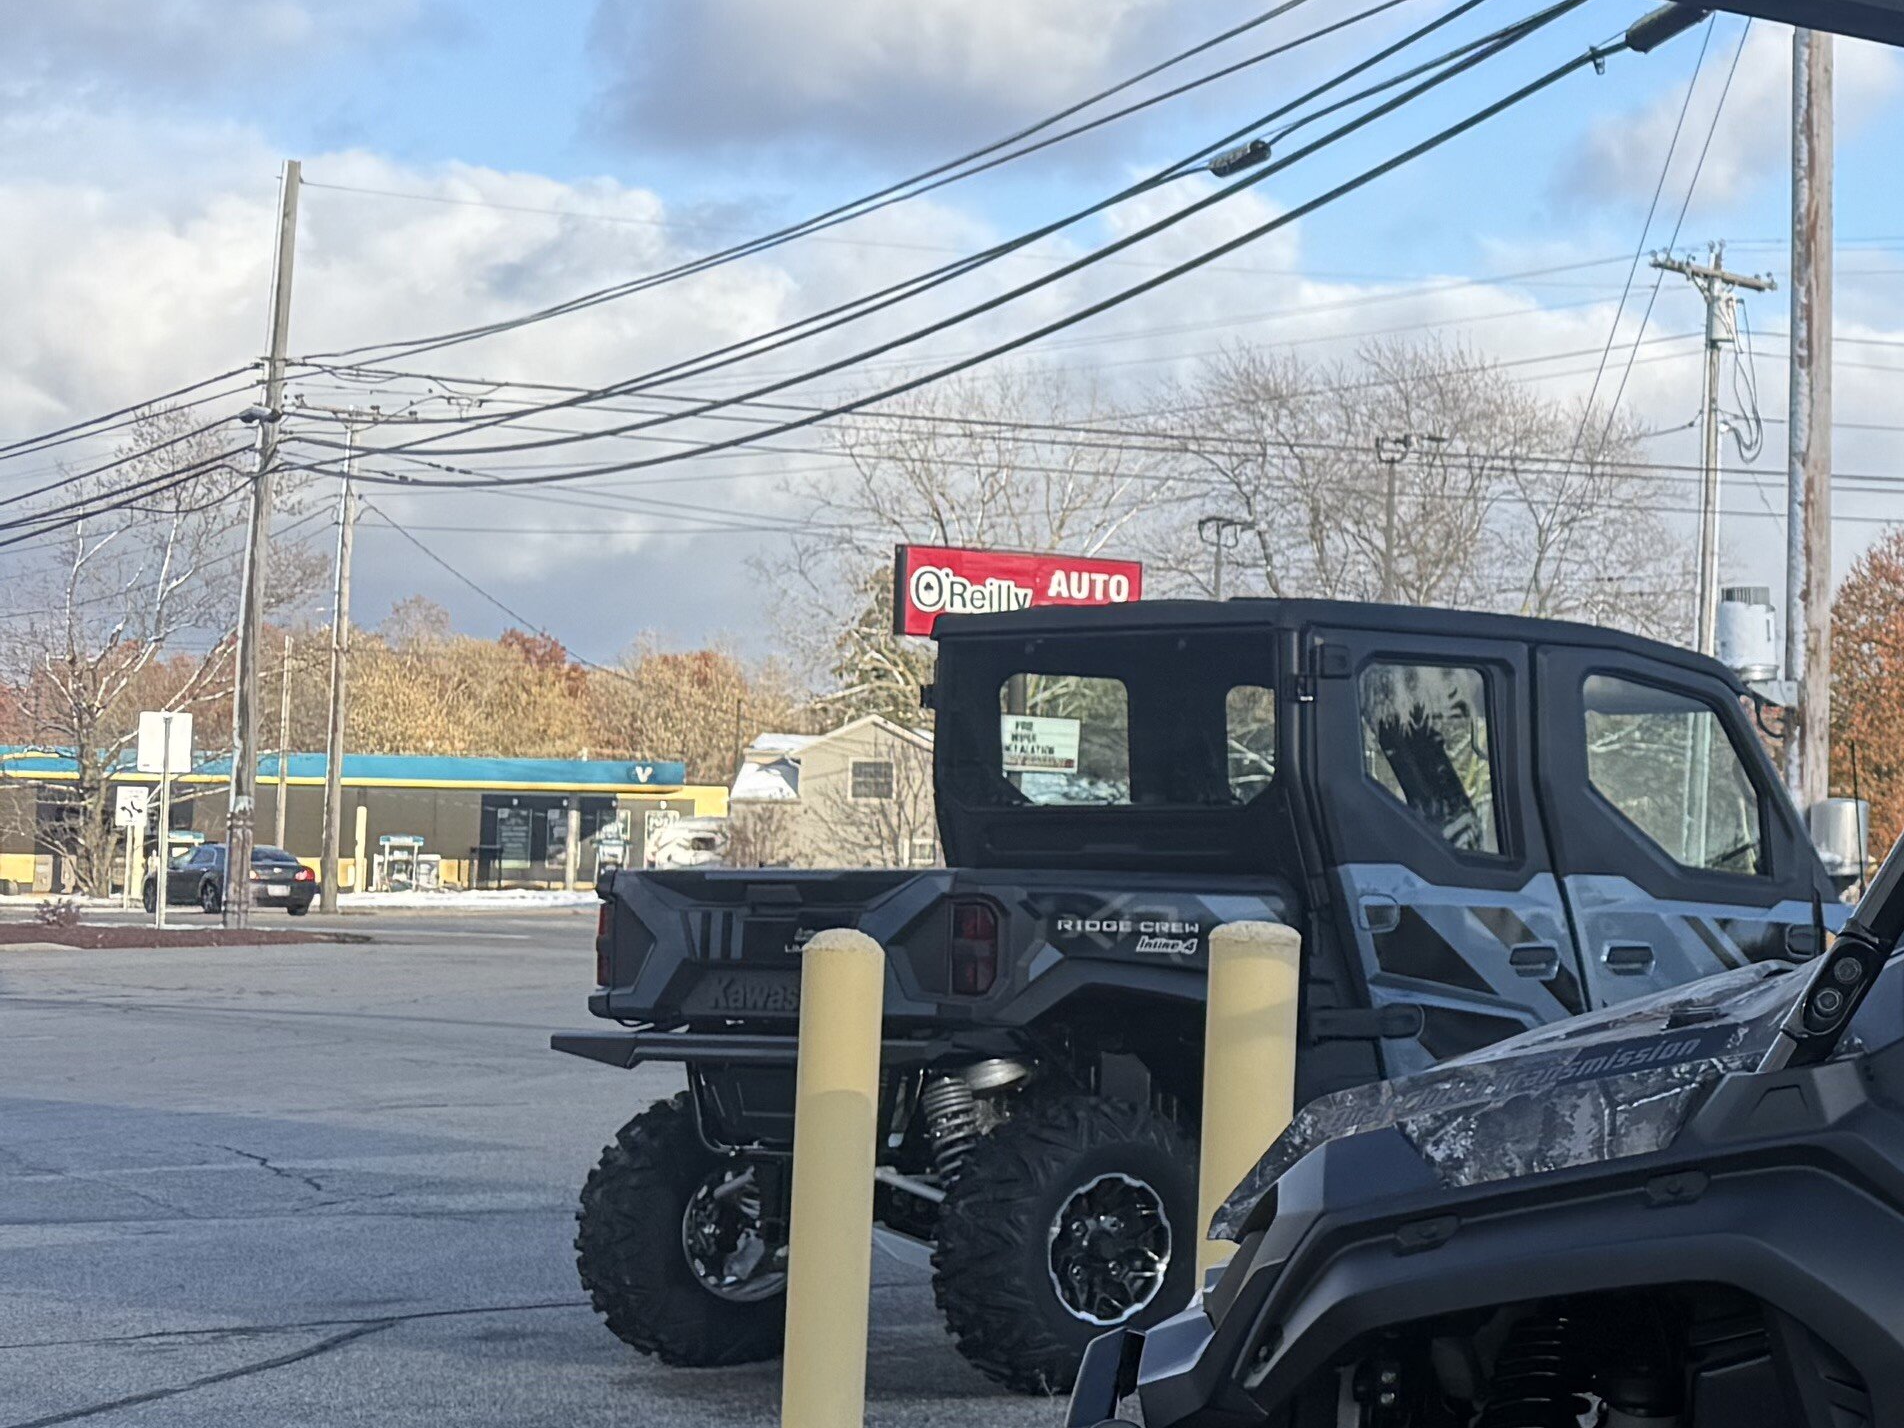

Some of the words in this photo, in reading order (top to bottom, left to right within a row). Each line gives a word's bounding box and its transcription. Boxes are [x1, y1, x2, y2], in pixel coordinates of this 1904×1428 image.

[1048, 570, 1130, 603] AUTO
[1057, 920, 1132, 933] RIDGE
[1139, 921, 1199, 934] CREW
[713, 976, 800, 1011] Kawas
[1502, 1038, 1701, 1094] Transmission
